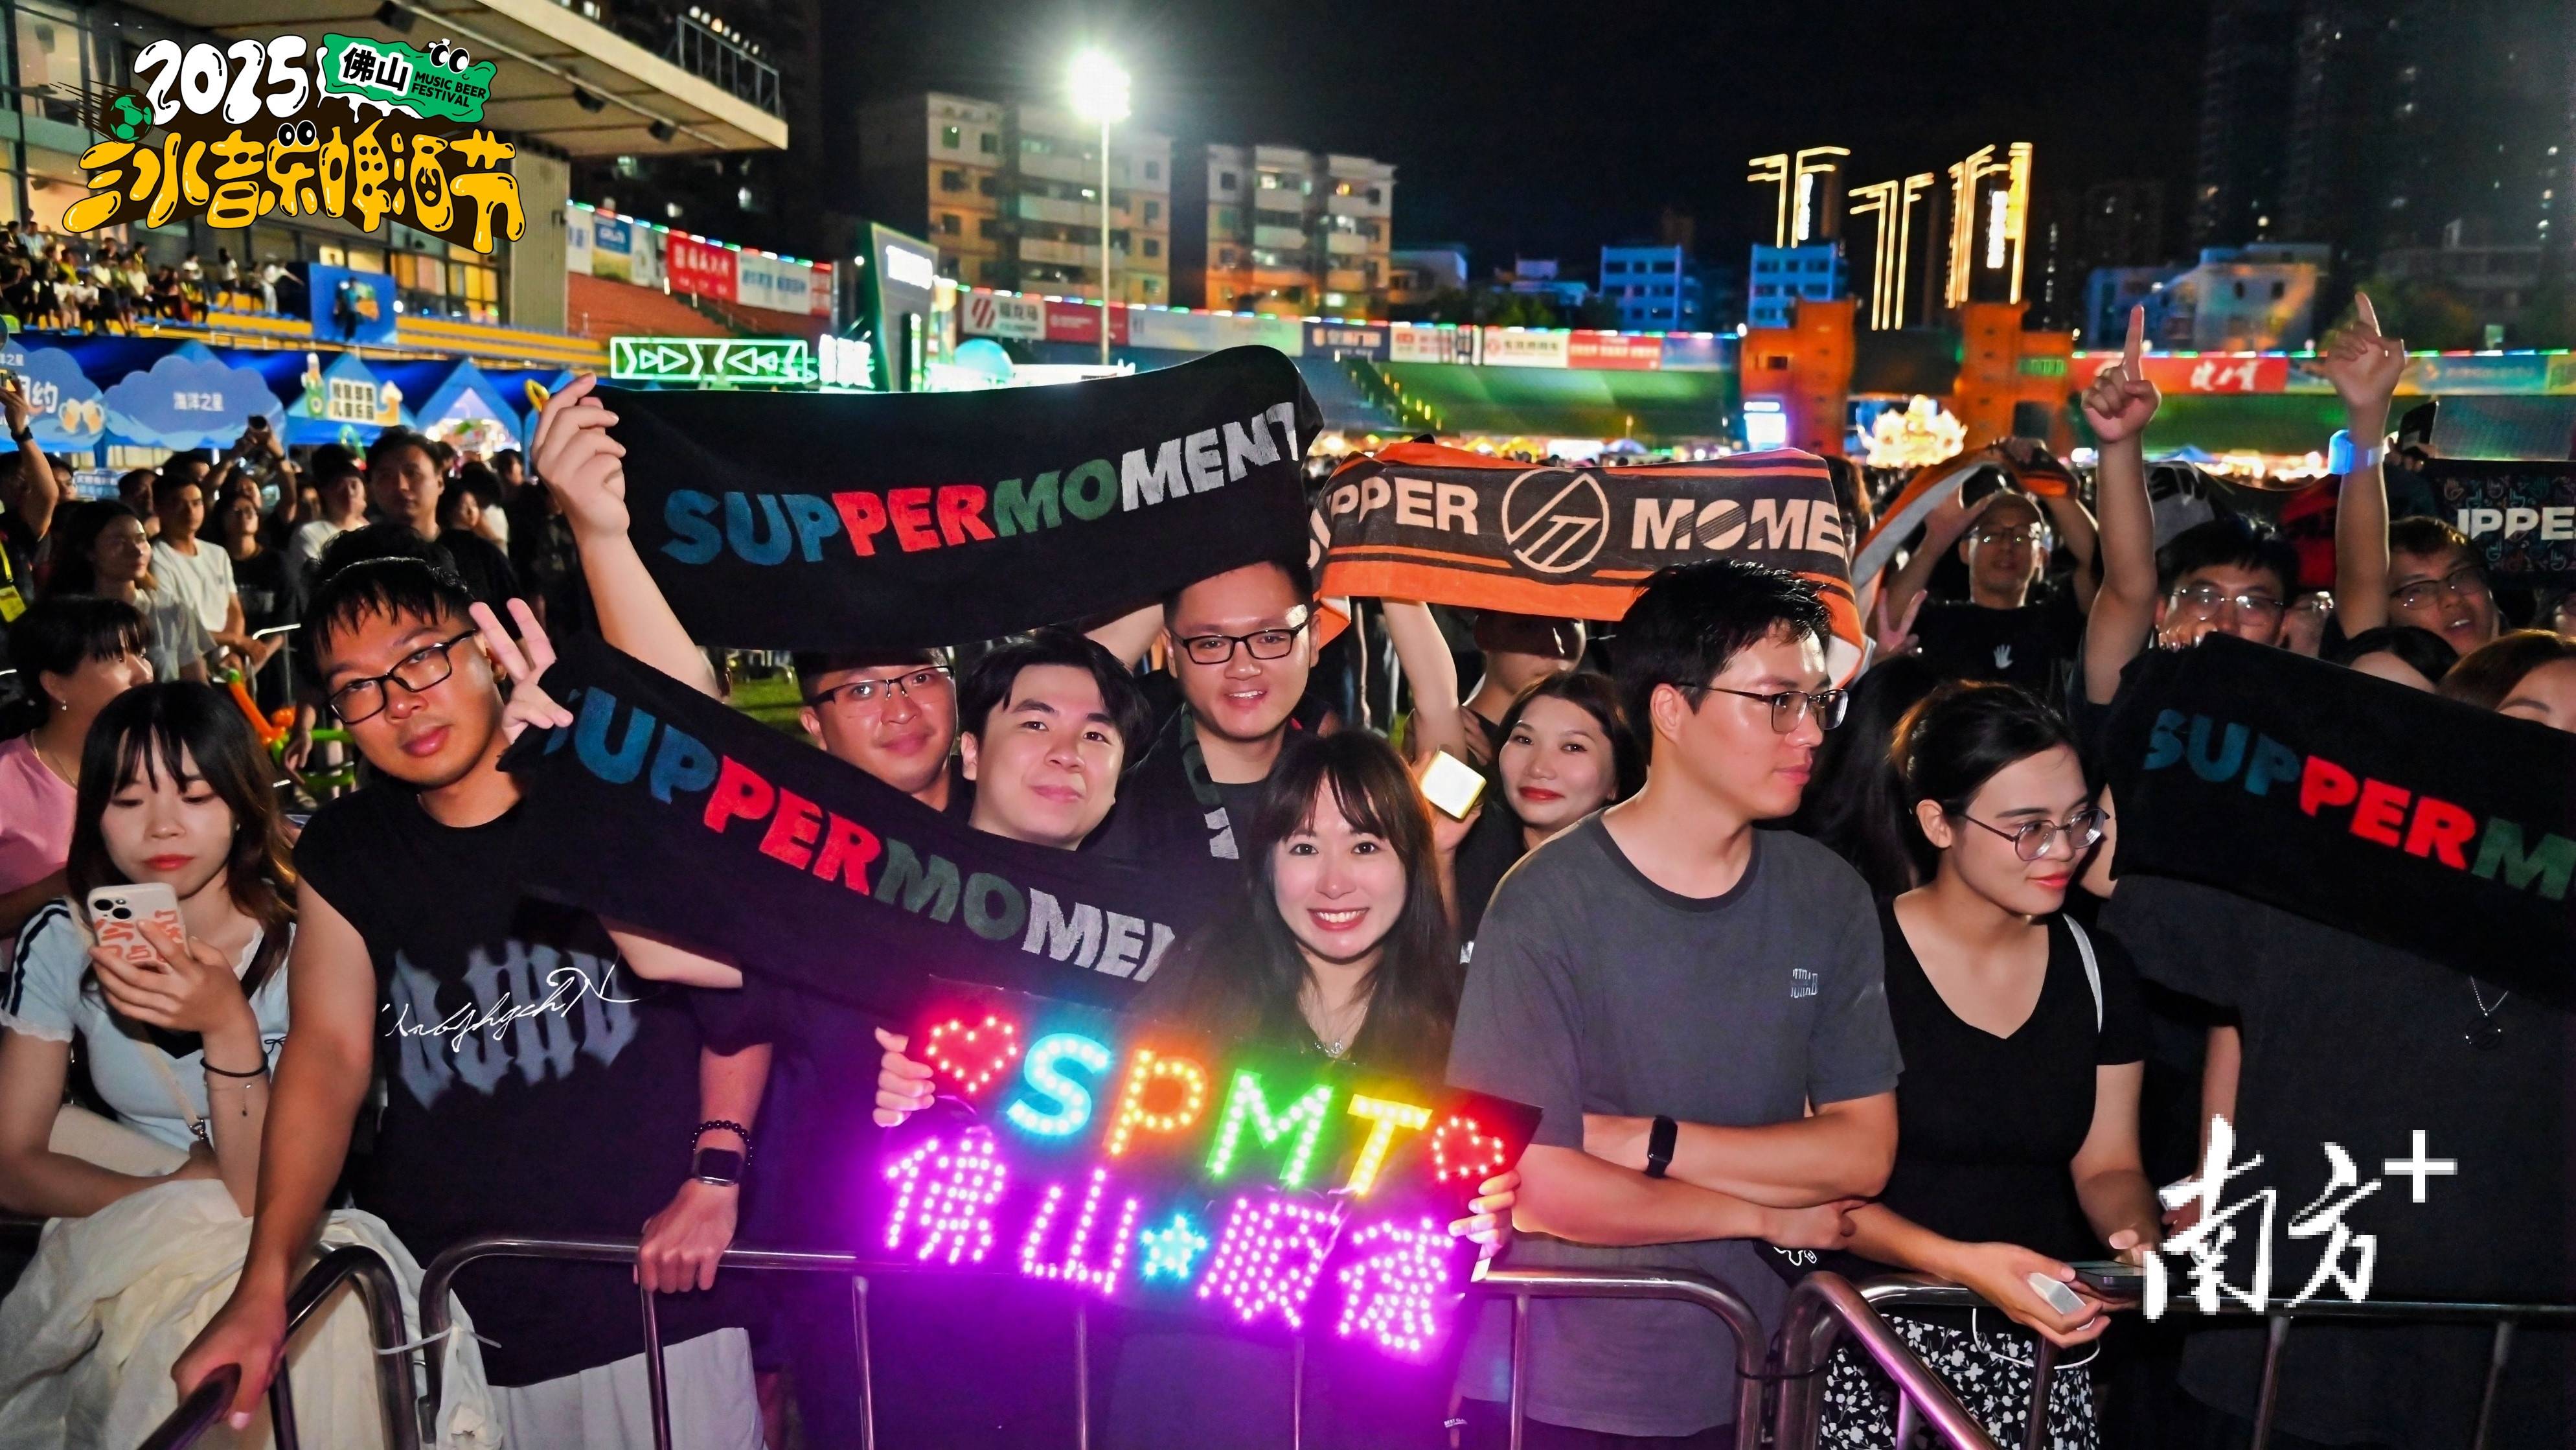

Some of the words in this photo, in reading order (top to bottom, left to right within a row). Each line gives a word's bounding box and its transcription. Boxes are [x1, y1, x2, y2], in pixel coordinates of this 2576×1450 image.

[174, 391, 224, 412] 海洋之星
[660, 401, 1301, 566] SUPPERMOMENT
[1327, 476, 1478, 535] PPER
[542, 685, 1175, 983] UPPERMOME
[1005, 1031, 1433, 1197] SPMT
[882, 1133, 1141, 1295] 佛山
